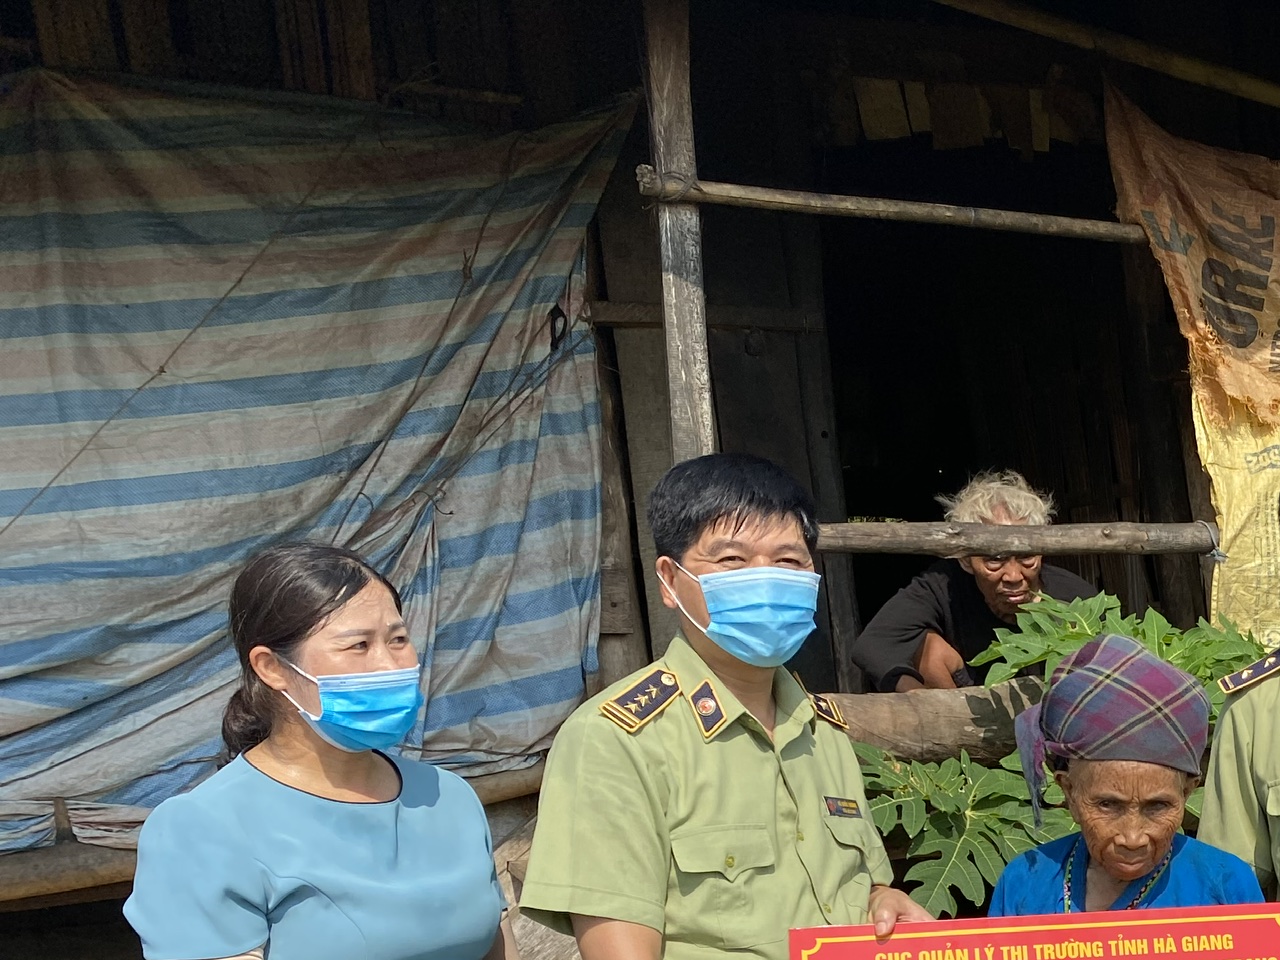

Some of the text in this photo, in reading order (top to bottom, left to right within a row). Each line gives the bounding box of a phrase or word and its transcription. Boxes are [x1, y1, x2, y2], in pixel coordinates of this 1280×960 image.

[1108, 934, 1149, 957] TỈNH
[1153, 934, 1178, 954] HÀ
[1182, 934, 1234, 953] GIANG
